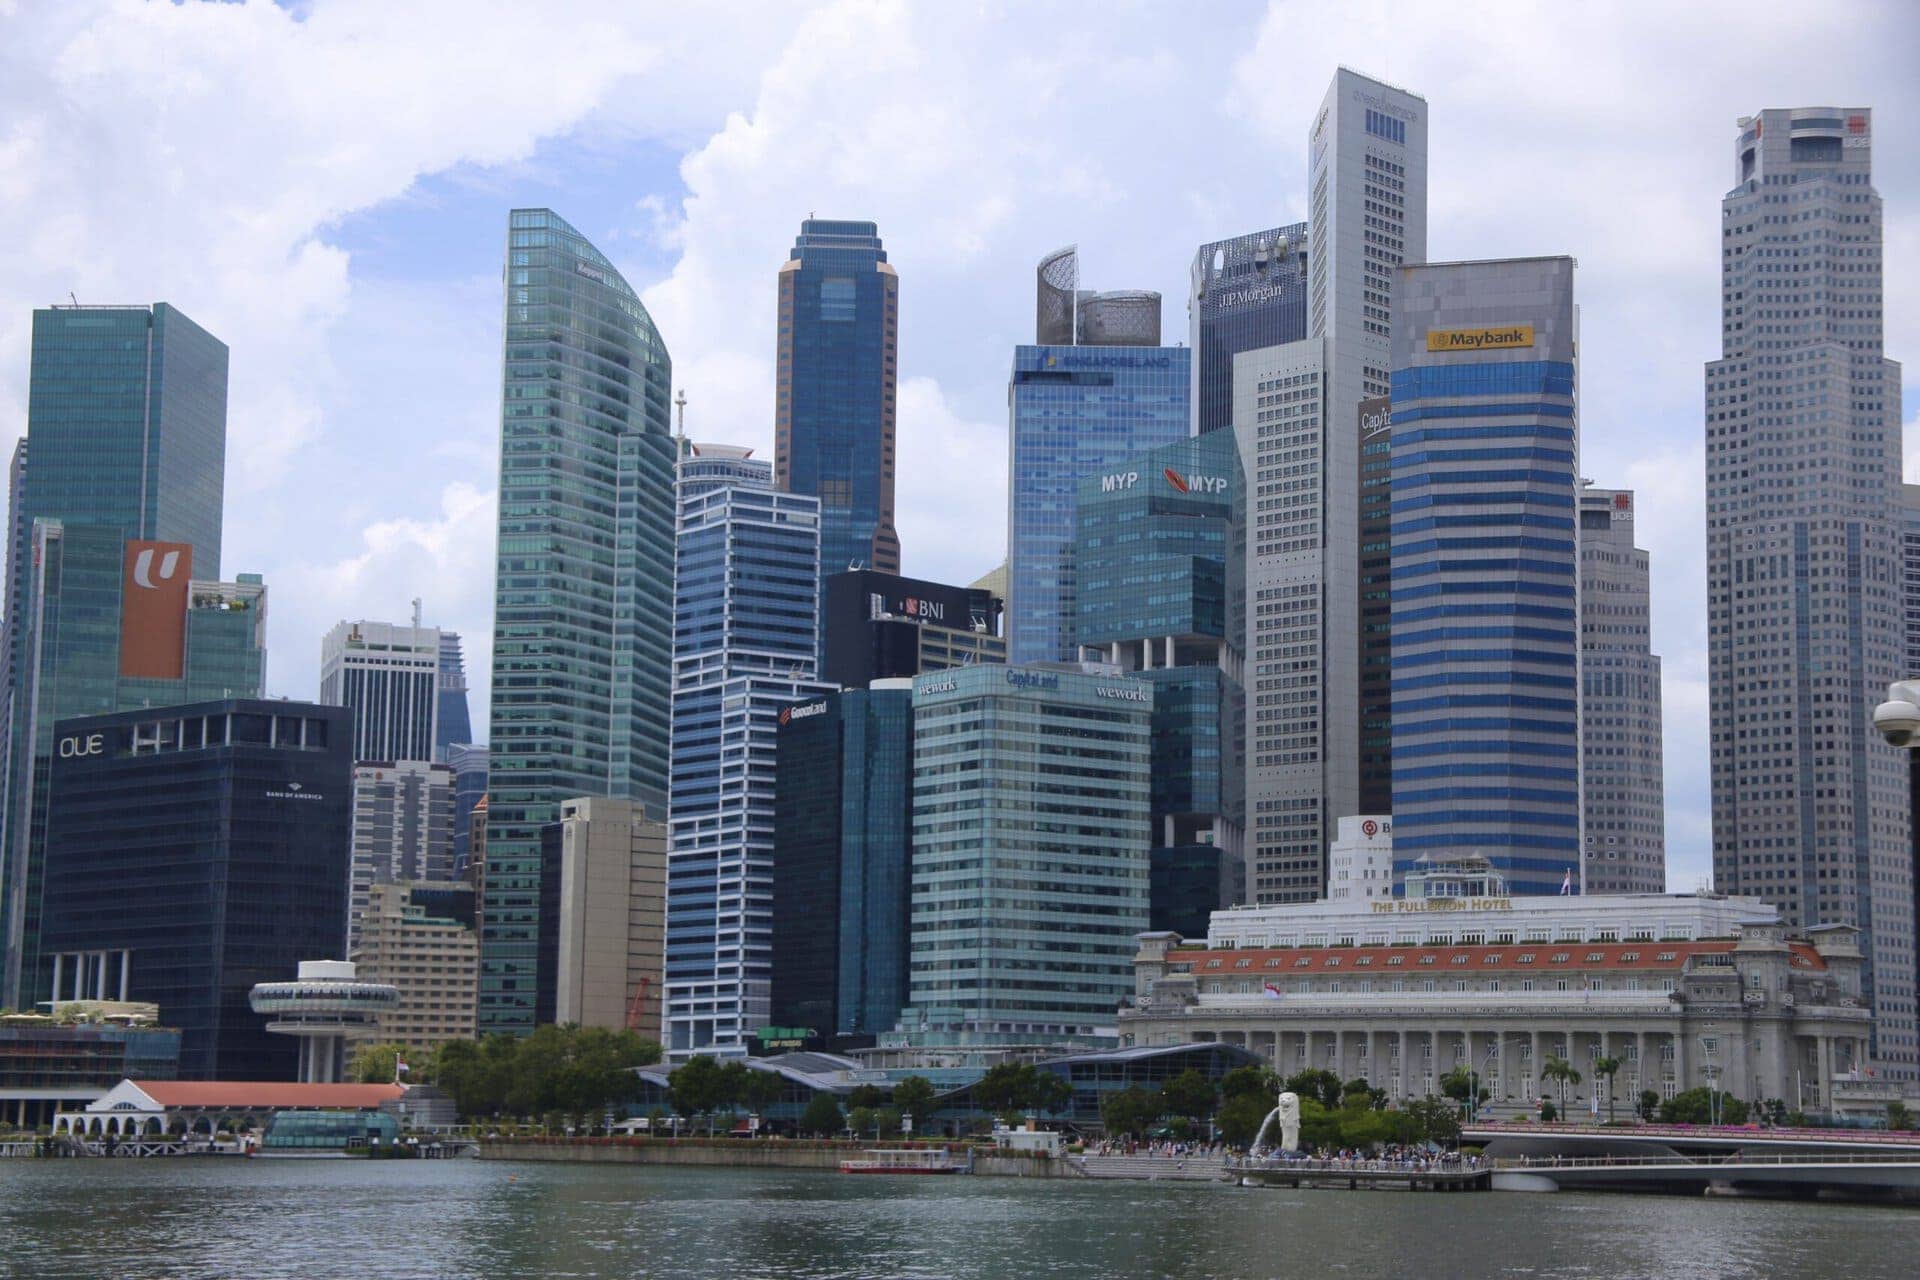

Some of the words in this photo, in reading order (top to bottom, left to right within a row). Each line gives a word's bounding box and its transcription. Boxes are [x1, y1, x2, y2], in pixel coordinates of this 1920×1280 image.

[1450, 330, 1523, 347] Maybank
[1102, 472, 1138, 492] MYP
[1189, 475, 1227, 494] MYP
[919, 600, 944, 619] BNI
[1097, 686, 1146, 701] wework
[60, 734, 104, 757] OUE
[1371, 902, 1394, 912] THE
[1398, 900, 1467, 912] FULLERTON
[1471, 898, 1513, 910] HOTEL
